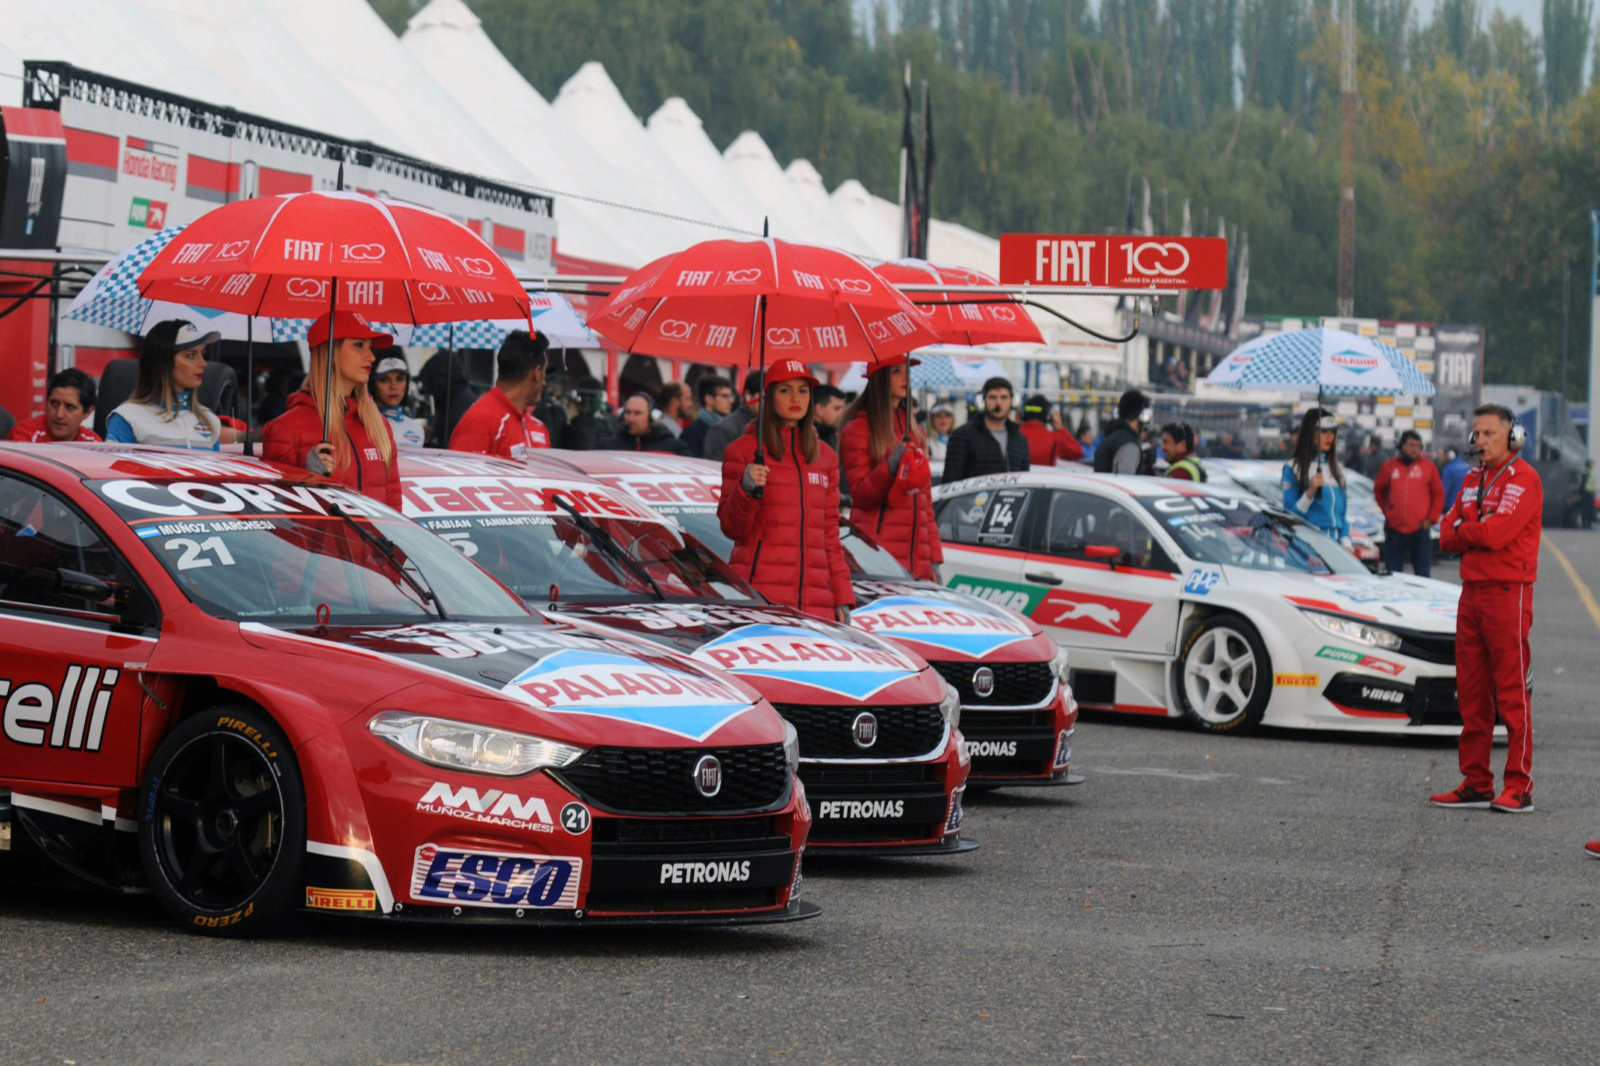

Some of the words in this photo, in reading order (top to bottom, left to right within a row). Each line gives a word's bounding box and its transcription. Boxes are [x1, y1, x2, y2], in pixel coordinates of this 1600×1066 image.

[172, 243, 213, 264] FIAT
[283, 238, 324, 261] FIAT
[340, 243, 386, 260] 100
[417, 247, 453, 273] FIAT
[454, 256, 494, 275] 100
[1036, 239, 1096, 282] FIAT
[1120, 241, 1190, 276] 100
[676, 270, 714, 287] FIAT
[725, 268, 762, 283] 100
[792, 270, 824, 290] FIAT
[833, 278, 872, 293] 100
[1123, 276, 1141, 284] AÑOS
[1330, 355, 1379, 366] PALADINI
[1438, 351, 1476, 386] FIAT
[428, 519, 471, 530] FABIAN
[989, 503, 1014, 527] 14
[157, 521, 210, 536] MUÑOZ
[213, 520, 276, 533] MARCHESI
[1180, 524, 1217, 540] 14
[164, 536, 236, 571] 21
[216, 716, 280, 759] PIRELLI
[859, 723, 874, 739] FIAT
[702, 768, 717, 786] FIAT
[416, 802, 475, 821] MUÑOZ
[477, 813, 555, 833] MARCHESI
[566, 808, 586, 829] 21
[819, 800, 904, 819] PETRONAS
[419, 850, 574, 907] ESCO
[660, 860, 751, 884] PETRONAS
[307, 890, 374, 910] PIRELLI
